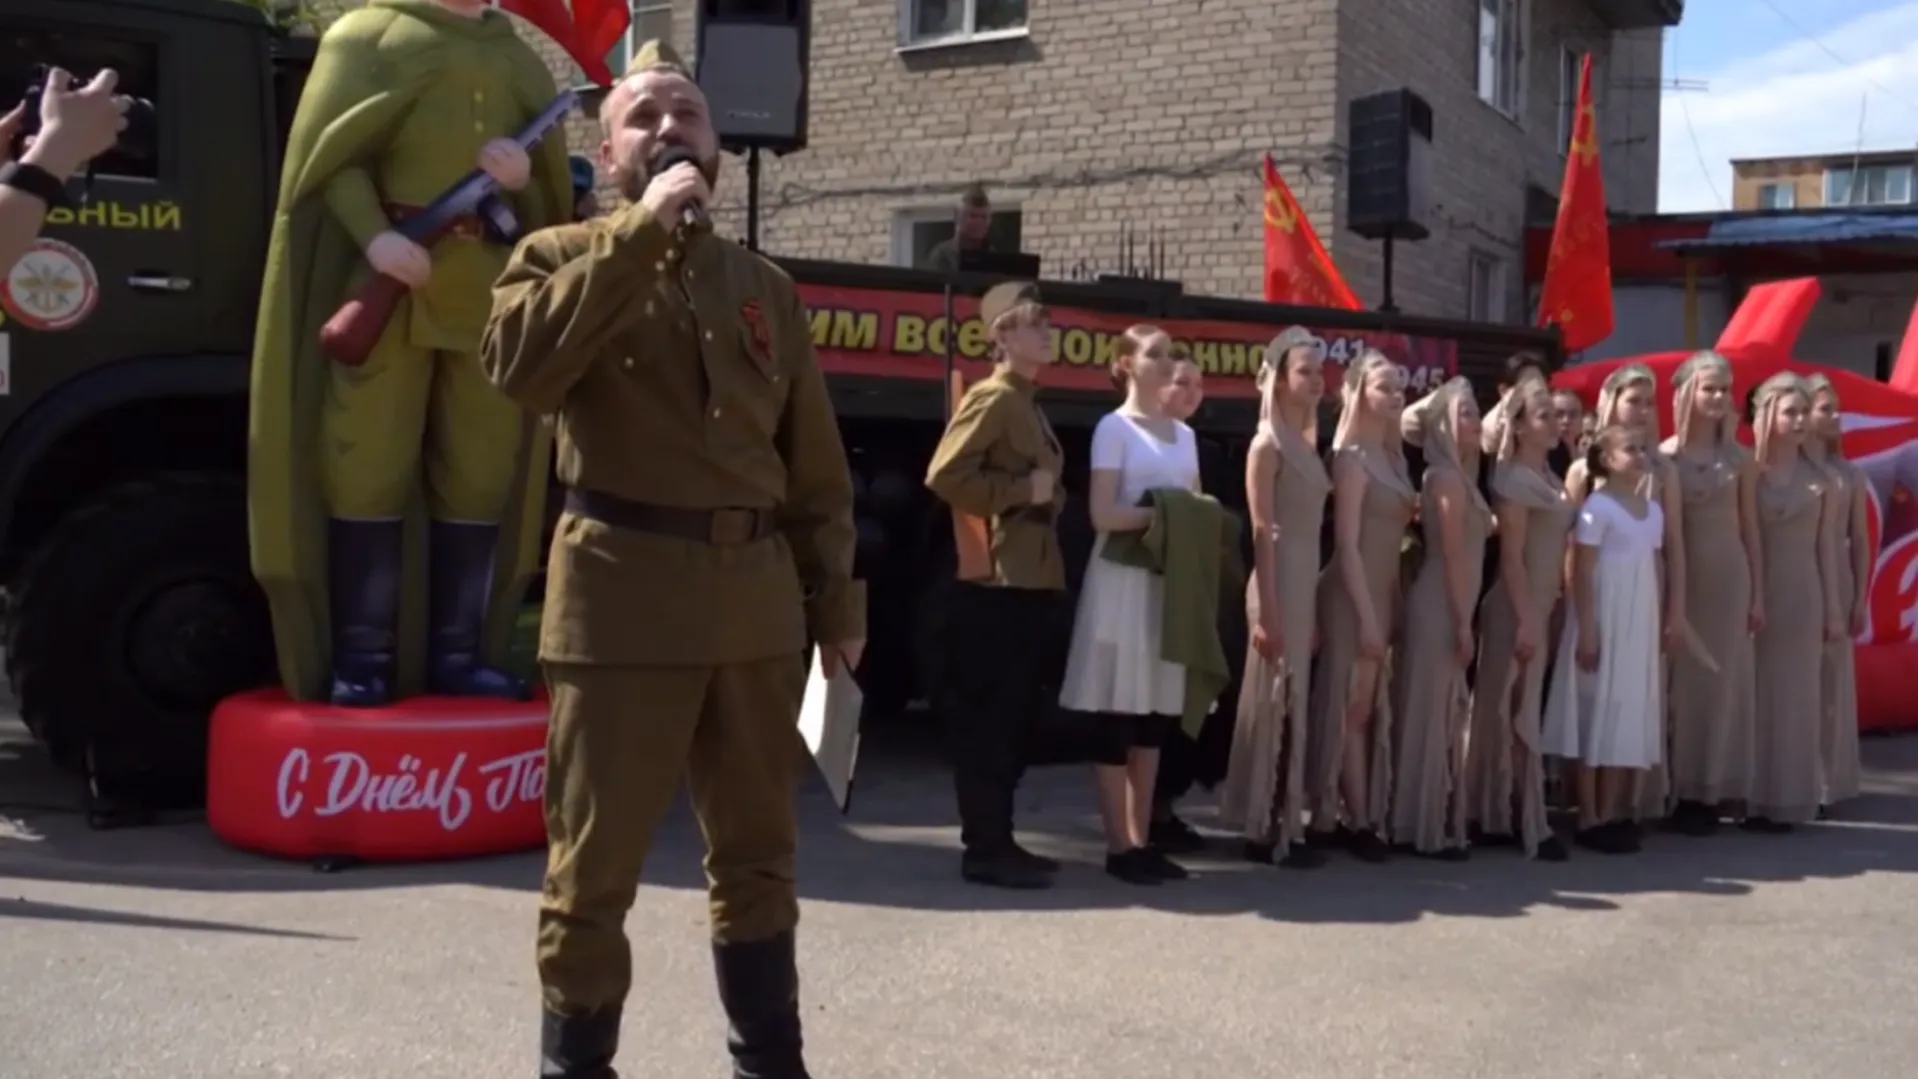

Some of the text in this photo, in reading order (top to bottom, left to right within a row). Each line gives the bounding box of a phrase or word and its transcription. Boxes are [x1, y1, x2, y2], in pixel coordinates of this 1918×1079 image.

[46, 201, 181, 230] ЬНЫЙ
[806, 308, 878, 350] им
[1310, 336, 1365, 366] 941
[1398, 364, 1446, 394] 945
[277, 748, 548, 831] С Днём По
